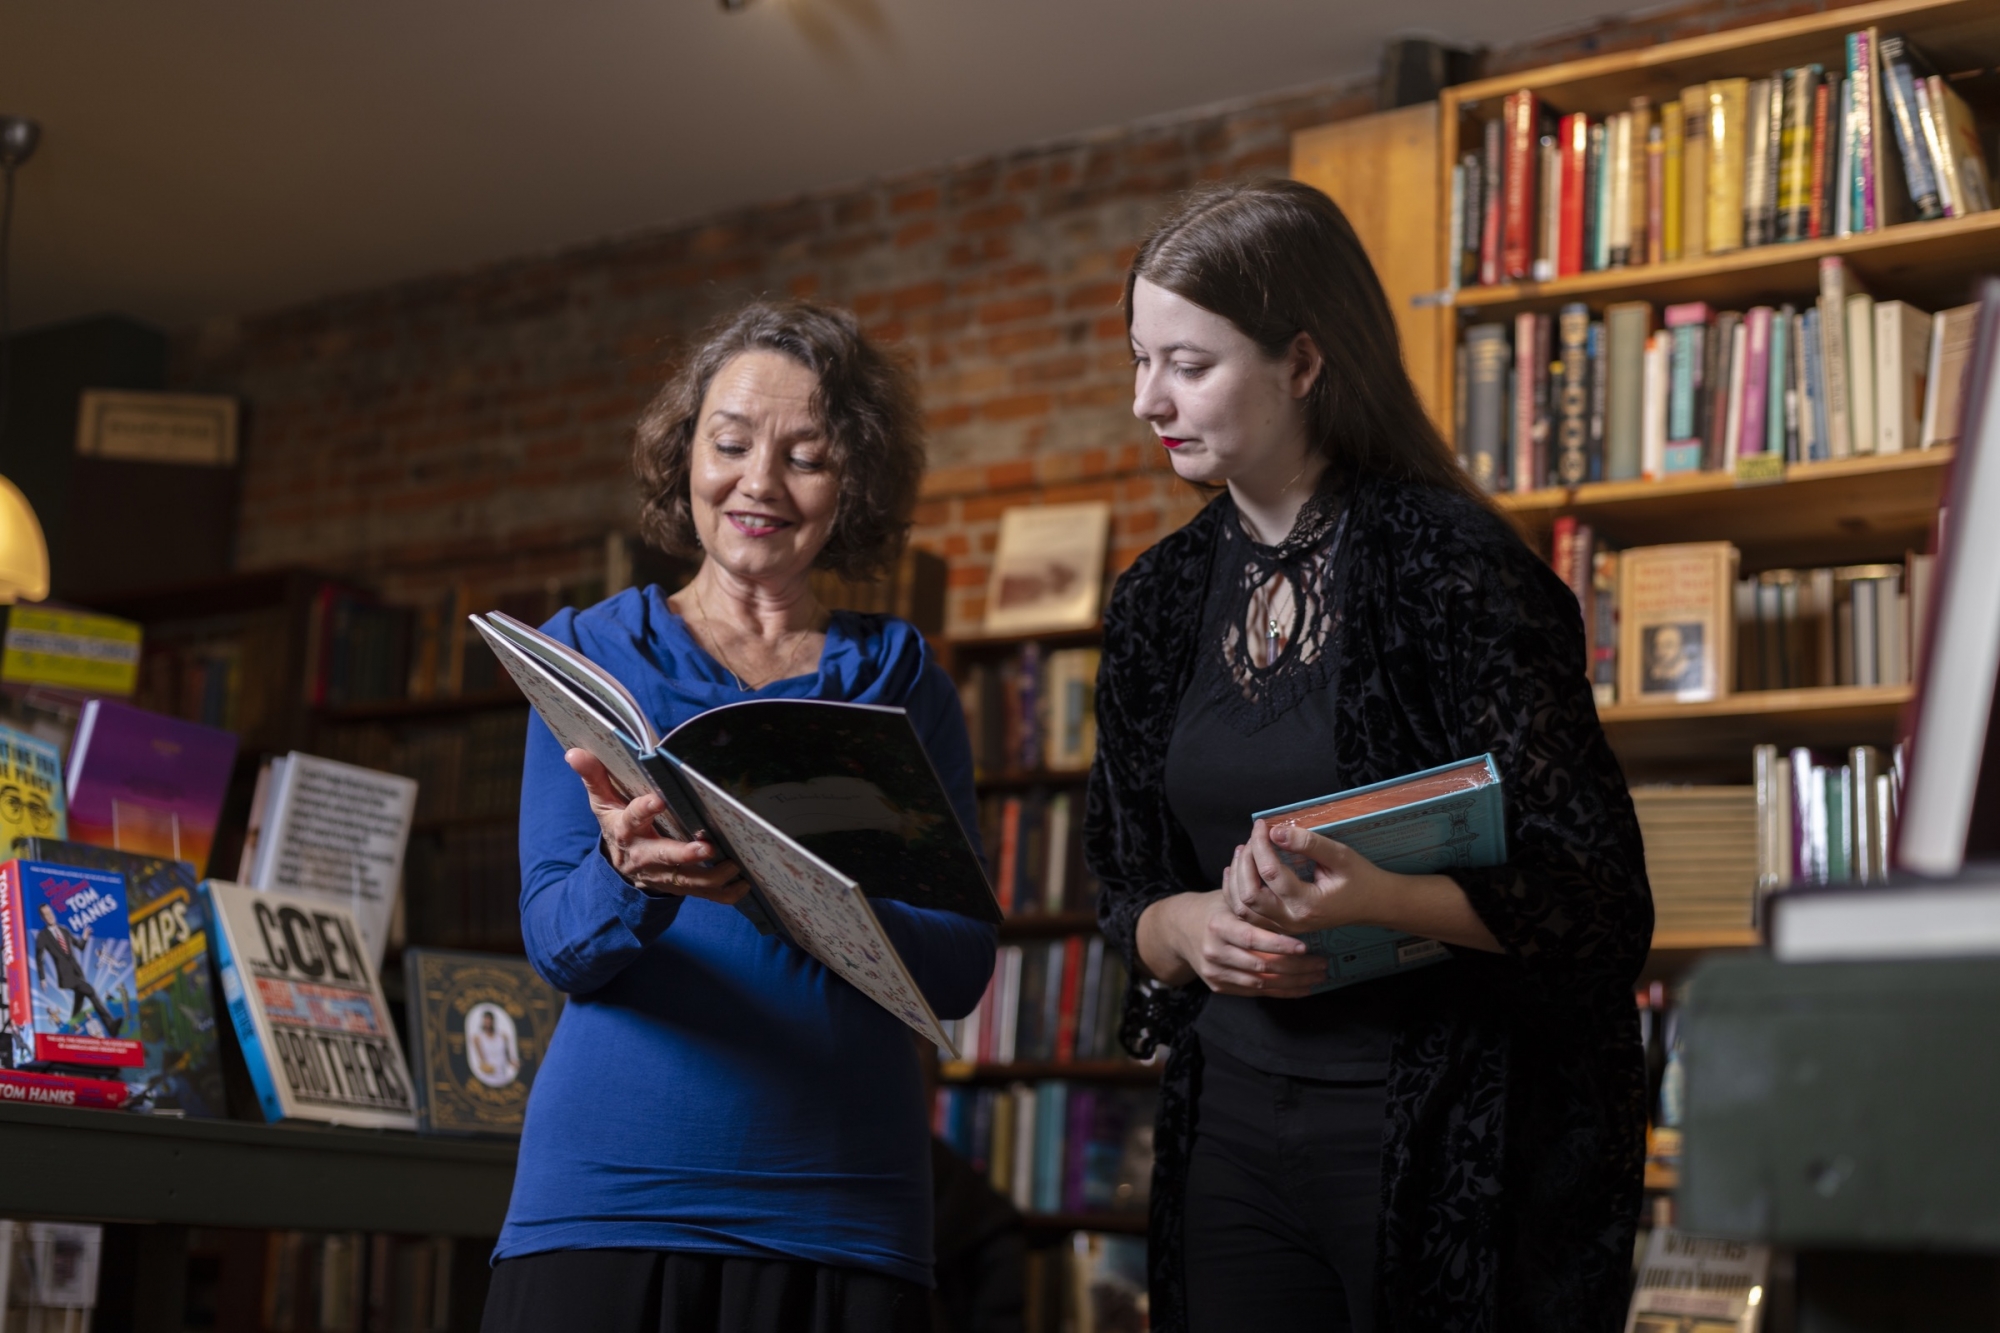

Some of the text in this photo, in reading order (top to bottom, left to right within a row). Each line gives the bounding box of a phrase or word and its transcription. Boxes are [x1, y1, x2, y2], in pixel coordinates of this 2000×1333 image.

[0, 869, 14, 966] TOM HANKS
[65, 886, 100, 913] TOM
[68, 893, 118, 933] HANKS
[130, 901, 190, 966] MAPS
[253, 900, 371, 986] COEN
[0, 1083, 26, 1100] TOM
[28, 1086, 76, 1105] HANKS
[273, 1029, 410, 1103] BROTHERS
